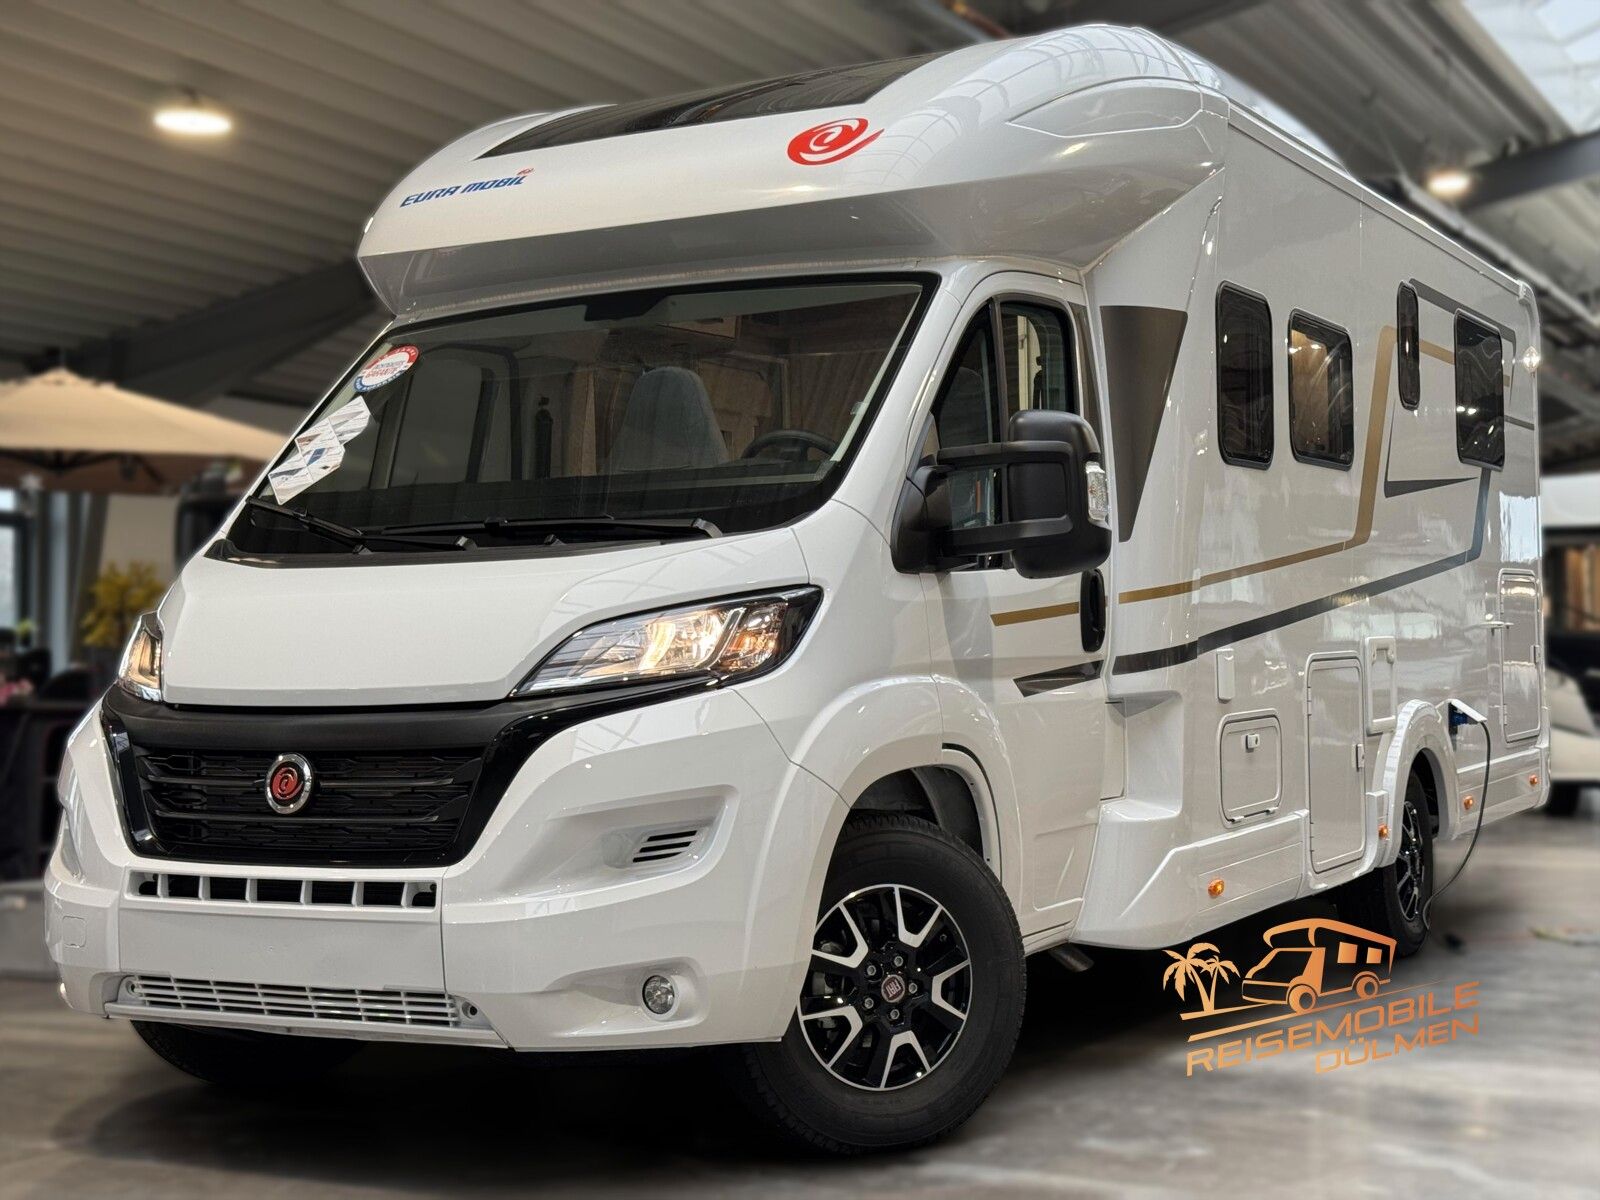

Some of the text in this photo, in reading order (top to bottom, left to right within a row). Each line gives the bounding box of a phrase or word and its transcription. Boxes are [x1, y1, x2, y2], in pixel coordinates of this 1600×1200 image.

[400, 176, 527, 208] EURA MOBIL
[885, 978, 902, 998] FIAT
